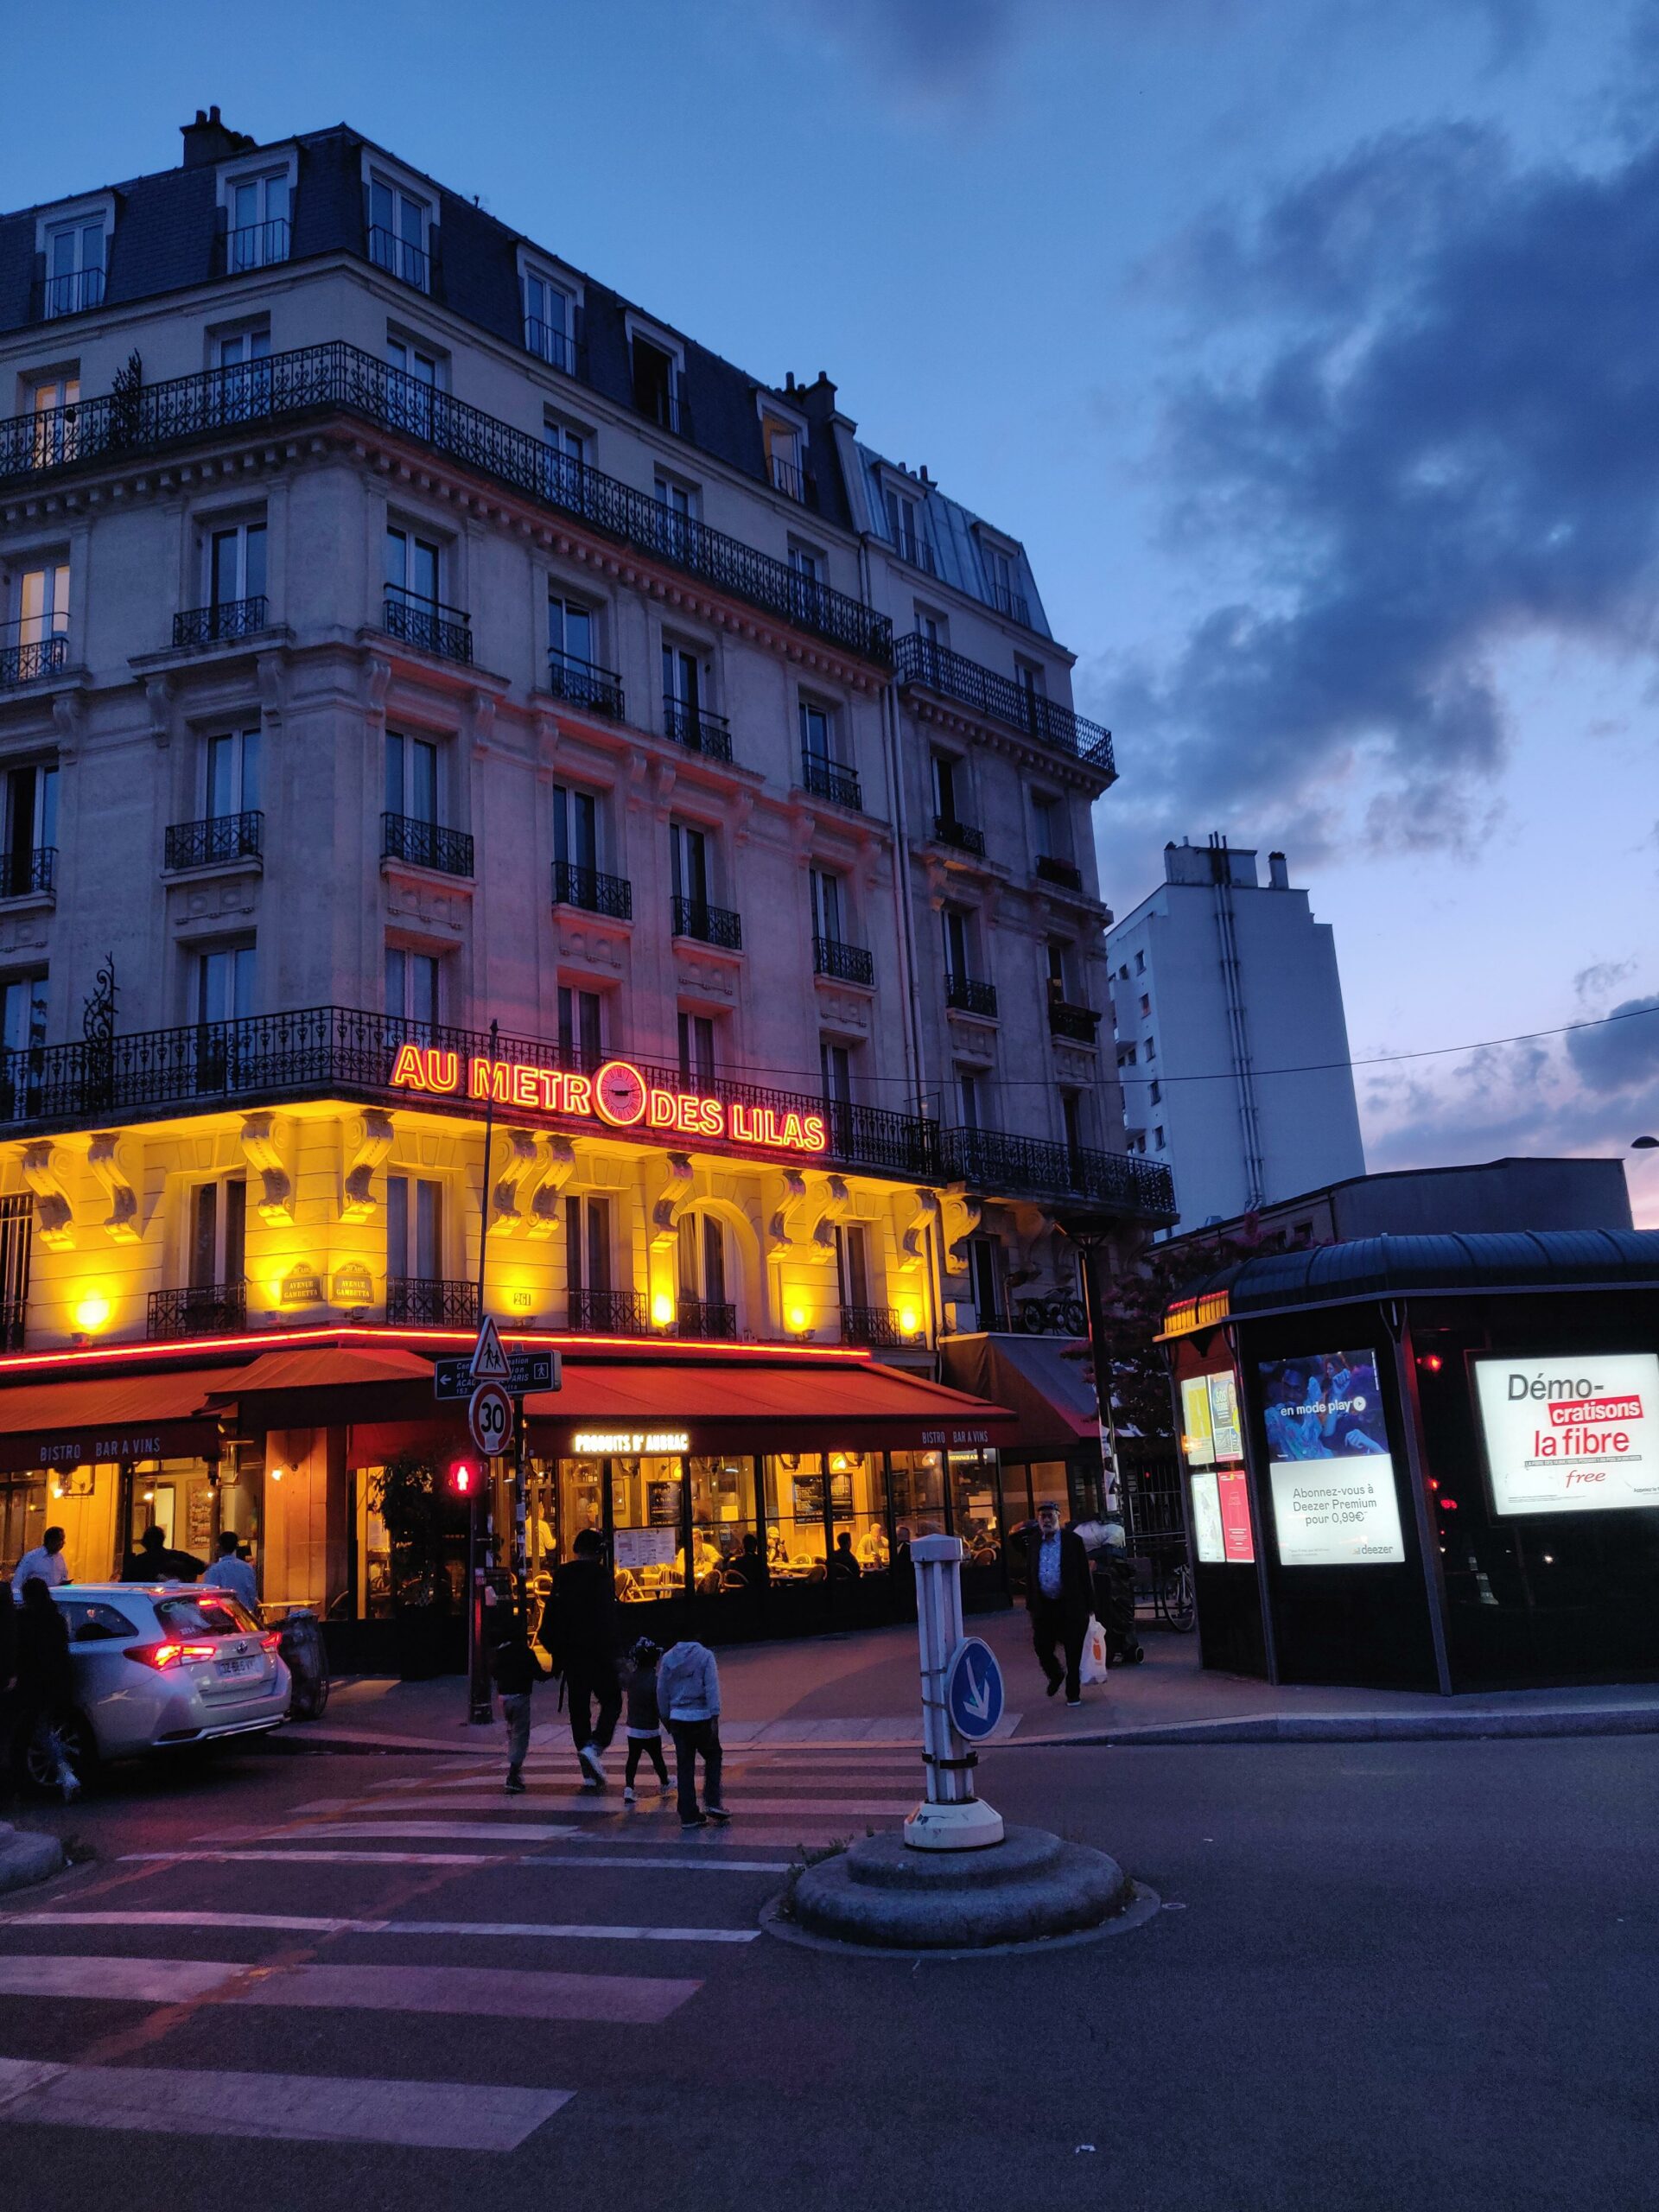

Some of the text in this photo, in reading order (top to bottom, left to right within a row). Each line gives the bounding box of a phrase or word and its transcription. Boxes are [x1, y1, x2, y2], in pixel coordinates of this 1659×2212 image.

[391, 1045, 827, 1152] AU METRO DES LILAS
[289, 1281, 314, 1289] AVENUE
[341, 1280, 365, 1288] AVENUE
[283, 1289, 318, 1299] GAMBETTA
[336, 1288, 370, 1298] GAMBETTA
[514, 1294, 531, 1305] 261
[1508, 1373, 1605, 1402] Démo-
[1281, 1399, 1353, 1417] en mode play
[1552, 1401, 1641, 1424] cratisons
[480, 1402, 505, 1434] 30
[575, 1434, 631, 1452] PRODUITS
[645, 1433, 689, 1452] AUBRAC
[922, 1431, 988, 1444] BISTRO BAR A VINS
[1535, 1427, 1630, 1458] la fibre
[40, 1437, 161, 1462] BISTRO BAR A VINS
[1566, 1470, 1607, 1489] free
[1293, 1483, 1374, 1499] Abonnez-vous à
[1293, 1498, 1377, 1512] Deezer Premium
[1306, 1515, 1330, 1527] pour
[1361, 1543, 1394, 1555] deezer
